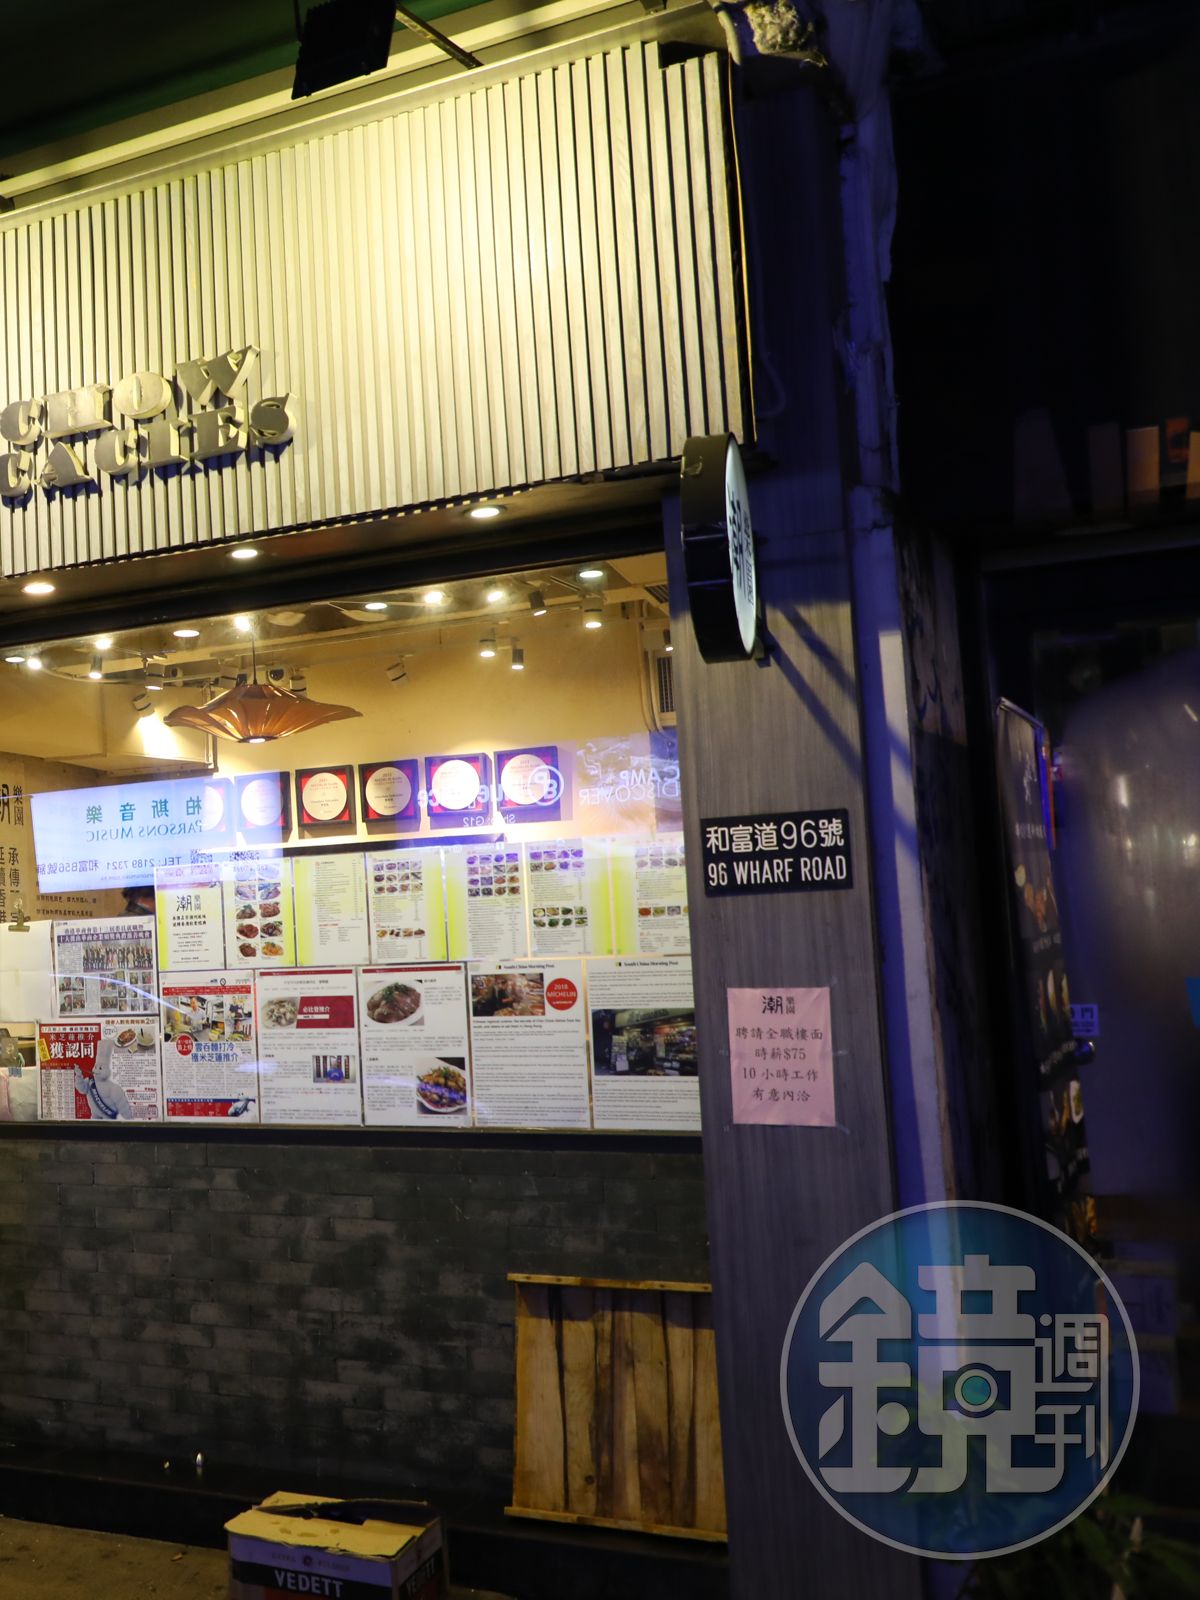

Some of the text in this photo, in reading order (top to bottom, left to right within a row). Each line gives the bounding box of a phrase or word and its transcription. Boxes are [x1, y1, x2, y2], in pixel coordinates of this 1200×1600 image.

[706, 818, 845, 854] 和富道96號
[708, 855, 847, 887] 96 WHARF ROAD
[547, 990, 577, 998] MICHELIN
[742, 1068, 756, 1080] 10
[274, 1569, 343, 1599] VEDETT
